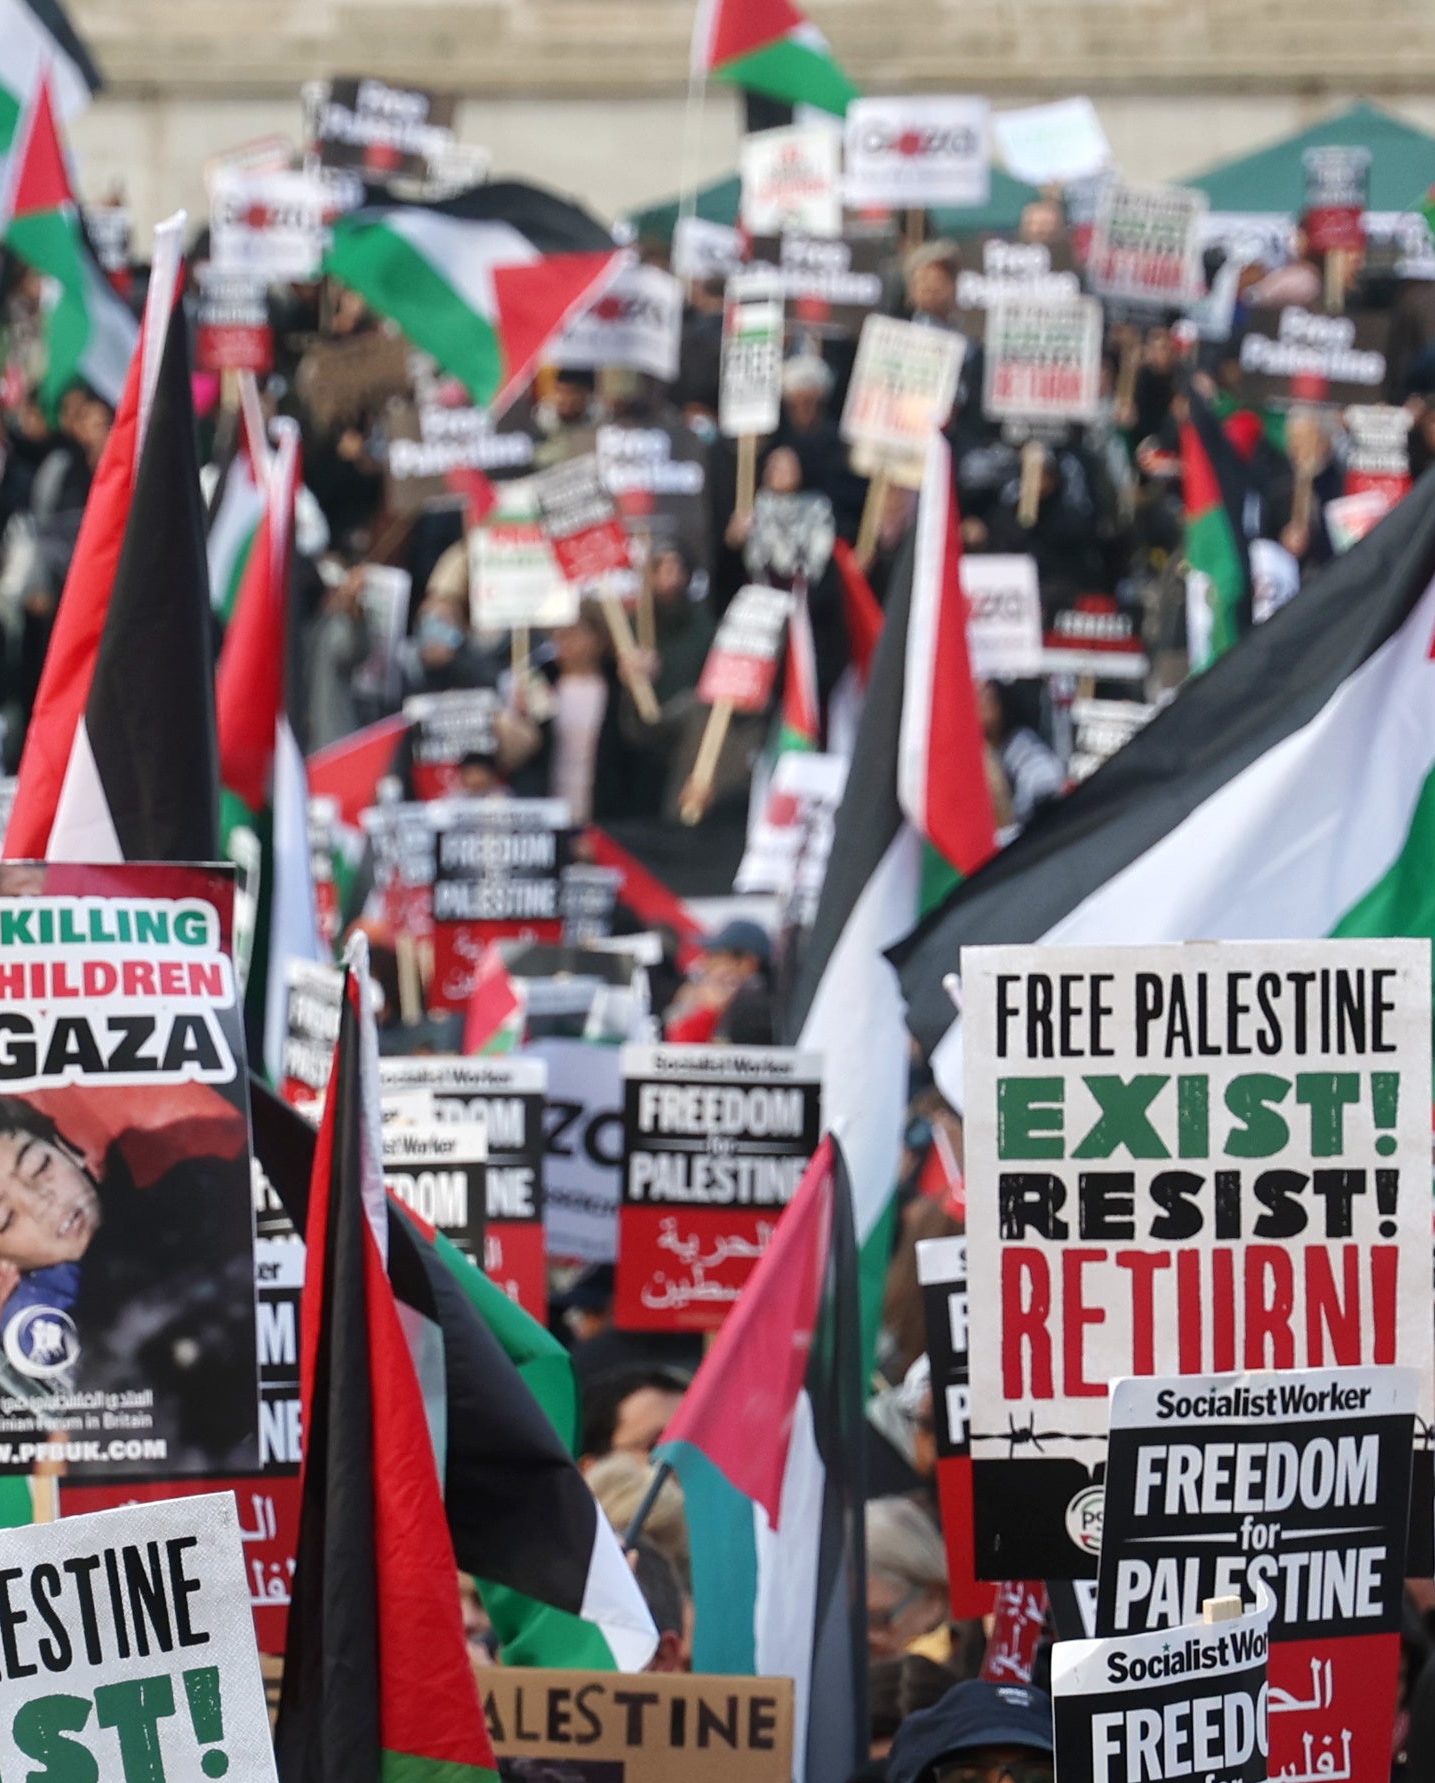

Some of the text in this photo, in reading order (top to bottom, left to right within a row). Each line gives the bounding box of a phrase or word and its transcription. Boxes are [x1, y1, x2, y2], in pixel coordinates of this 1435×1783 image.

[0, 908, 209, 948] KILLING
[996, 968, 1399, 1058] FREE PALESTINE
[638, 1088, 805, 1136] FREEDOM
[997, 1071, 1401, 1161] EXIST!
[998, 1168, 1400, 1241] RESIST!
[1134, 1434, 1381, 1518] FREEDOM
[1240, 1515, 1281, 1551] for
[486, 1683, 777, 1750] ALESTINE
